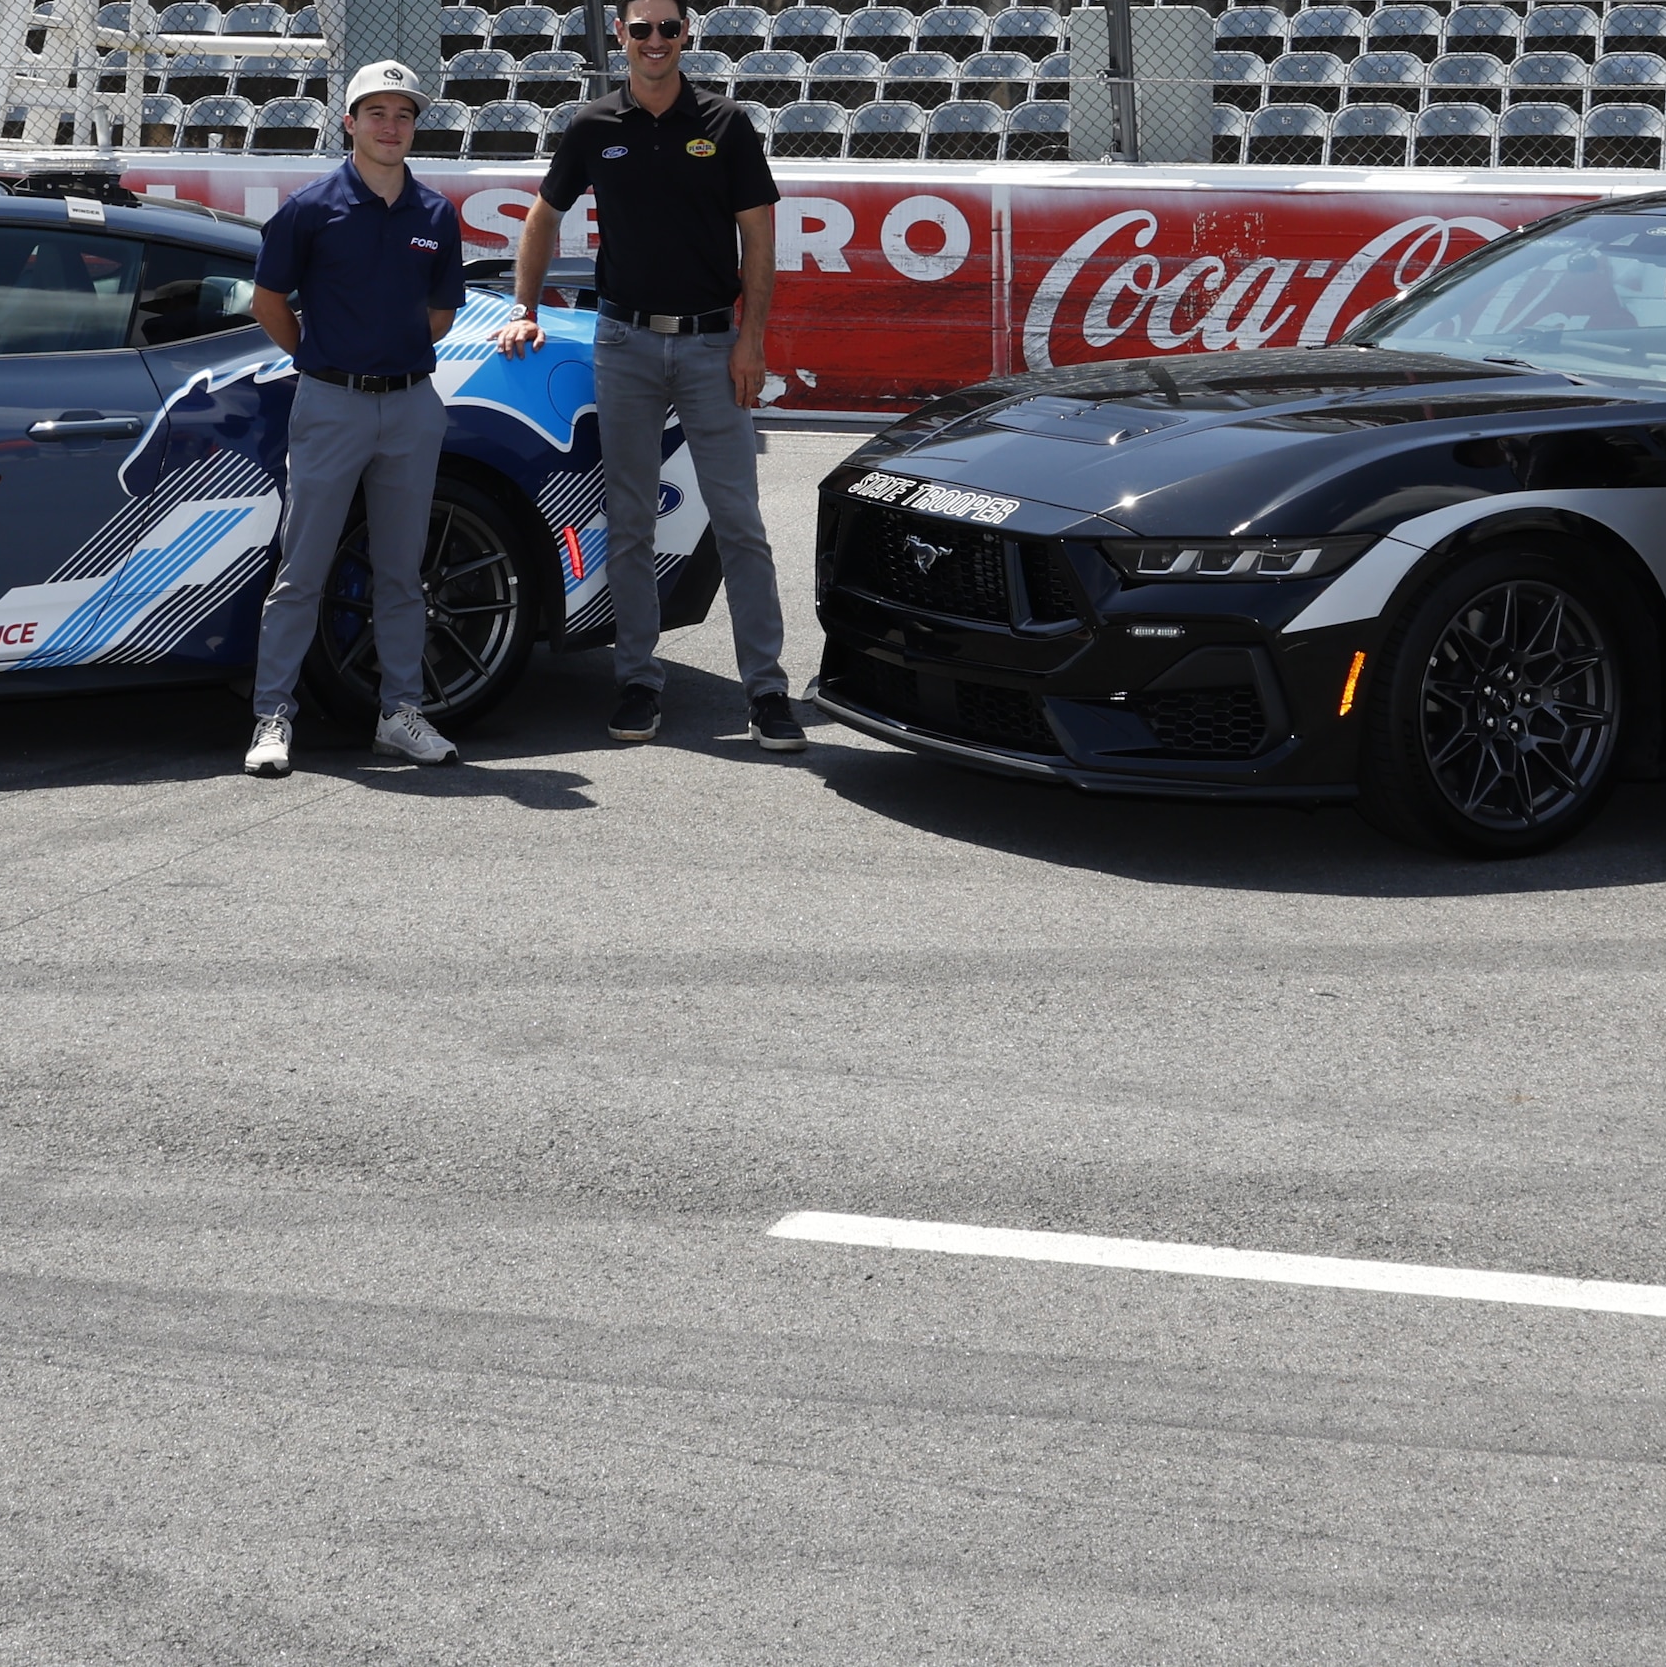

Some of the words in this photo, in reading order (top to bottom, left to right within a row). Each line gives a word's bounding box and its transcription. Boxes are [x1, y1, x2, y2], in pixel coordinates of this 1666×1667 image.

[410, 236, 439, 250] FORD
[848, 471, 917, 503] STATE
[901, 483, 1021, 525] TROOPER
